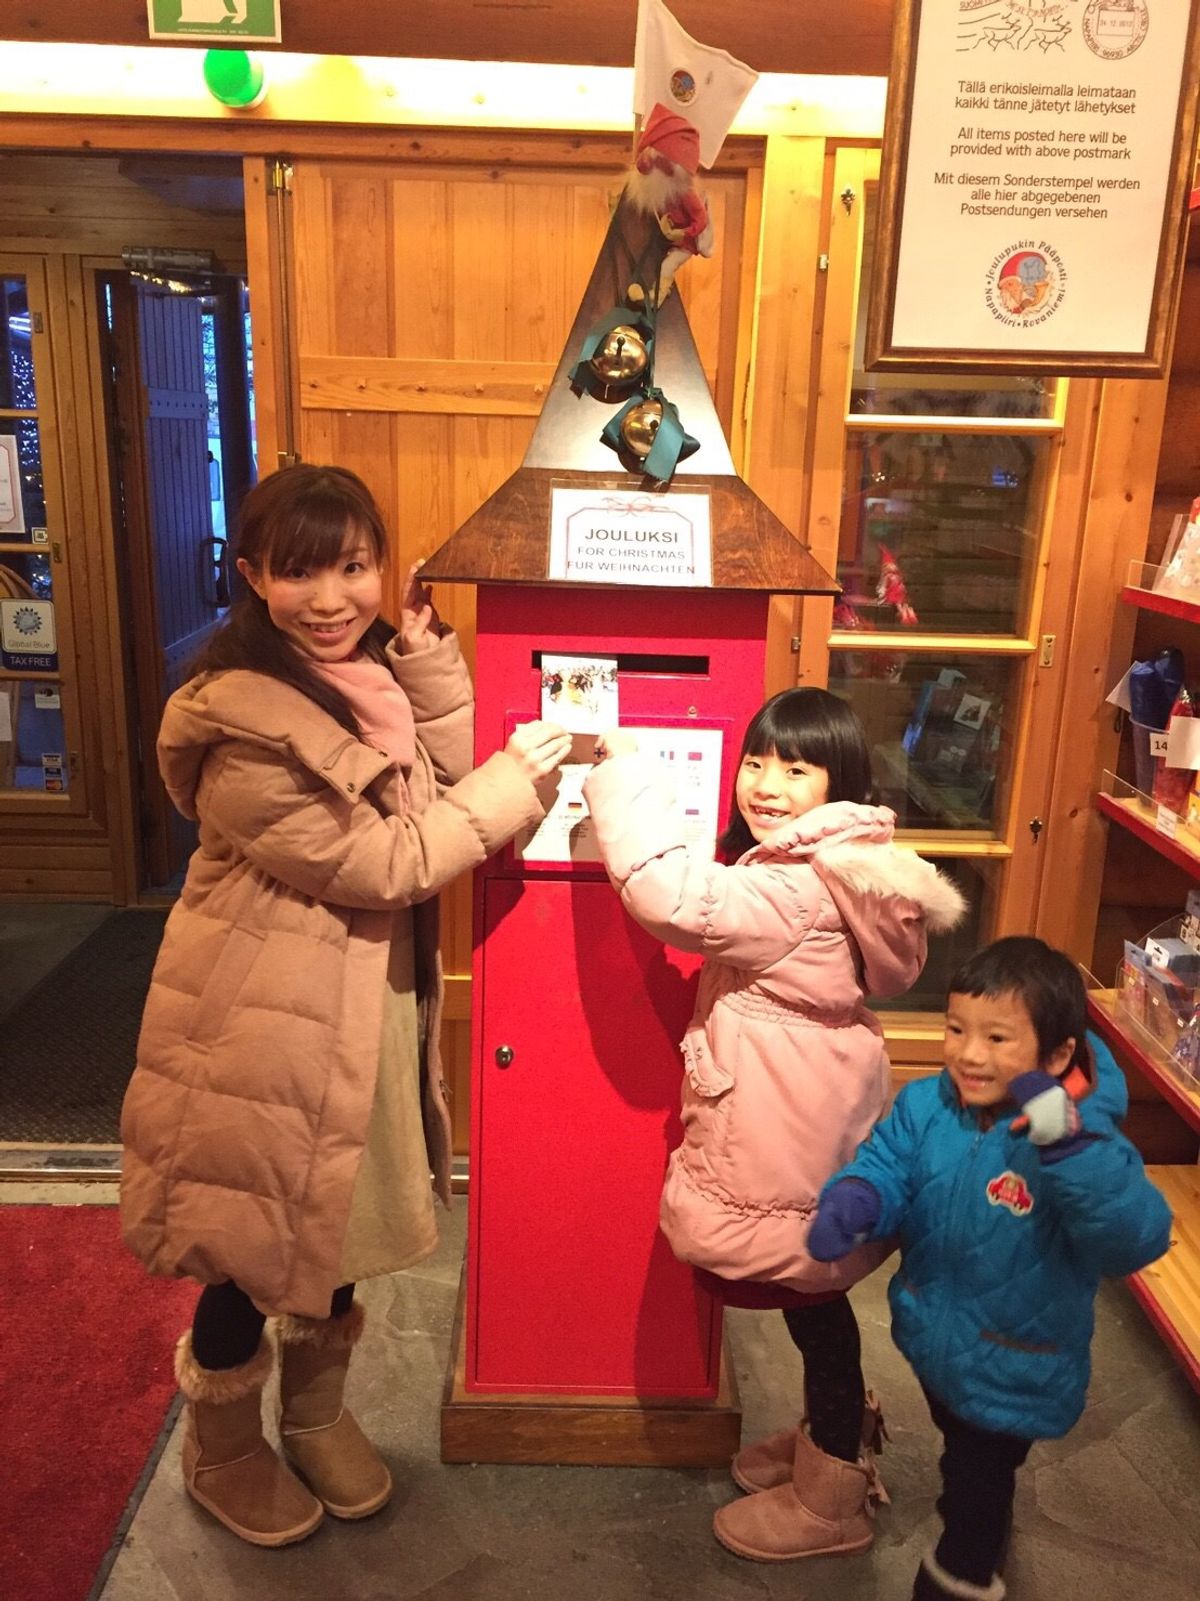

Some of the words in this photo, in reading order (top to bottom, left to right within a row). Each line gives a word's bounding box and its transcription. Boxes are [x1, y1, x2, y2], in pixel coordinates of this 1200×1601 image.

[958, 80, 986, 93] Tällä
[990, 82, 1073, 96] erikoisleimalla
[1077, 85, 1136, 98] leimataan
[955, 97, 989, 109] kaikki
[994, 98, 1028, 110] tänne
[1029, 99, 1070, 114] jätetyt
[1074, 100, 1136, 116] lähetykset
[958, 127, 972, 139] All
[976, 128, 1010, 140] items
[1014, 130, 1054, 143] posted
[1058, 130, 1085, 142] here
[1090, 132, 1108, 143] will
[1112, 132, 1127, 144] be
[950, 144, 1002, 157] provided
[1006, 145, 1031, 156] with
[1035, 146, 1070, 157] above
[1074, 148, 1131, 160] postmark
[934, 172, 954, 184] Mit
[958, 173, 1000, 185] diesem
[1004, 174, 1093, 190] Sonderstempel
[1097, 178, 1140, 189] werden
[971, 189, 991, 200] alle
[995, 189, 1017, 201] hier
[1021, 191, 1100, 204] abgegebenen
[961, 203, 1051, 219] Postsendungen
[1055, 206, 1108, 218] versehen
[986, 240, 1035, 280] Joulupukin
[1038, 241, 1068, 281] Pääposti
[985, 288, 1016, 328] Napapiiri
[1022, 288, 1066, 328] Rovaniemi
[585, 529, 678, 543] JOULUKSI
[578, 547, 605, 556] FOR
[608, 548, 685, 560] CHRISTMAS
[597, 562, 695, 574] WEIHNACHTEN
[10, 656, 27, 665] TAX
[29, 657, 52, 666] FREE
[1155, 741, 1168, 751] 14
